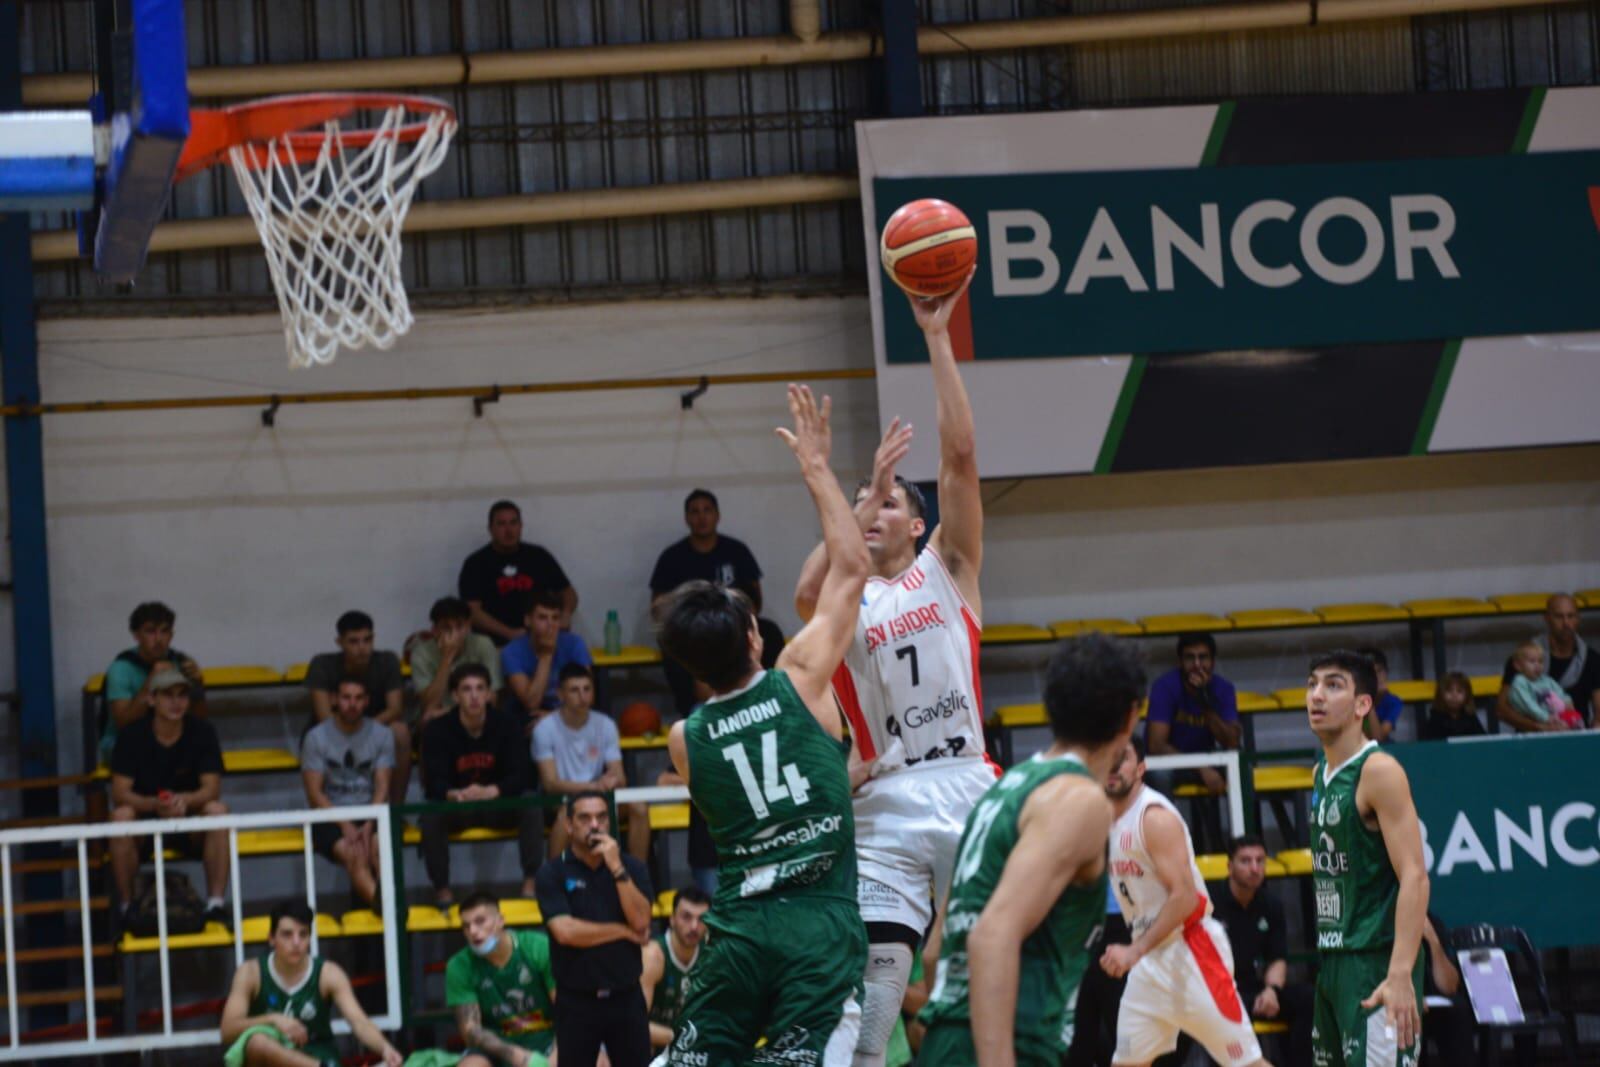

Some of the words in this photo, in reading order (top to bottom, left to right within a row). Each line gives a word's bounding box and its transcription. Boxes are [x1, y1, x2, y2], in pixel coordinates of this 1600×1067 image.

[987, 194, 1460, 297] BANCOR
[895, 644, 919, 687] 7
[707, 697, 782, 740] LANDONI
[721, 729, 811, 820] 14
[1418, 801, 1600, 876] ANC
